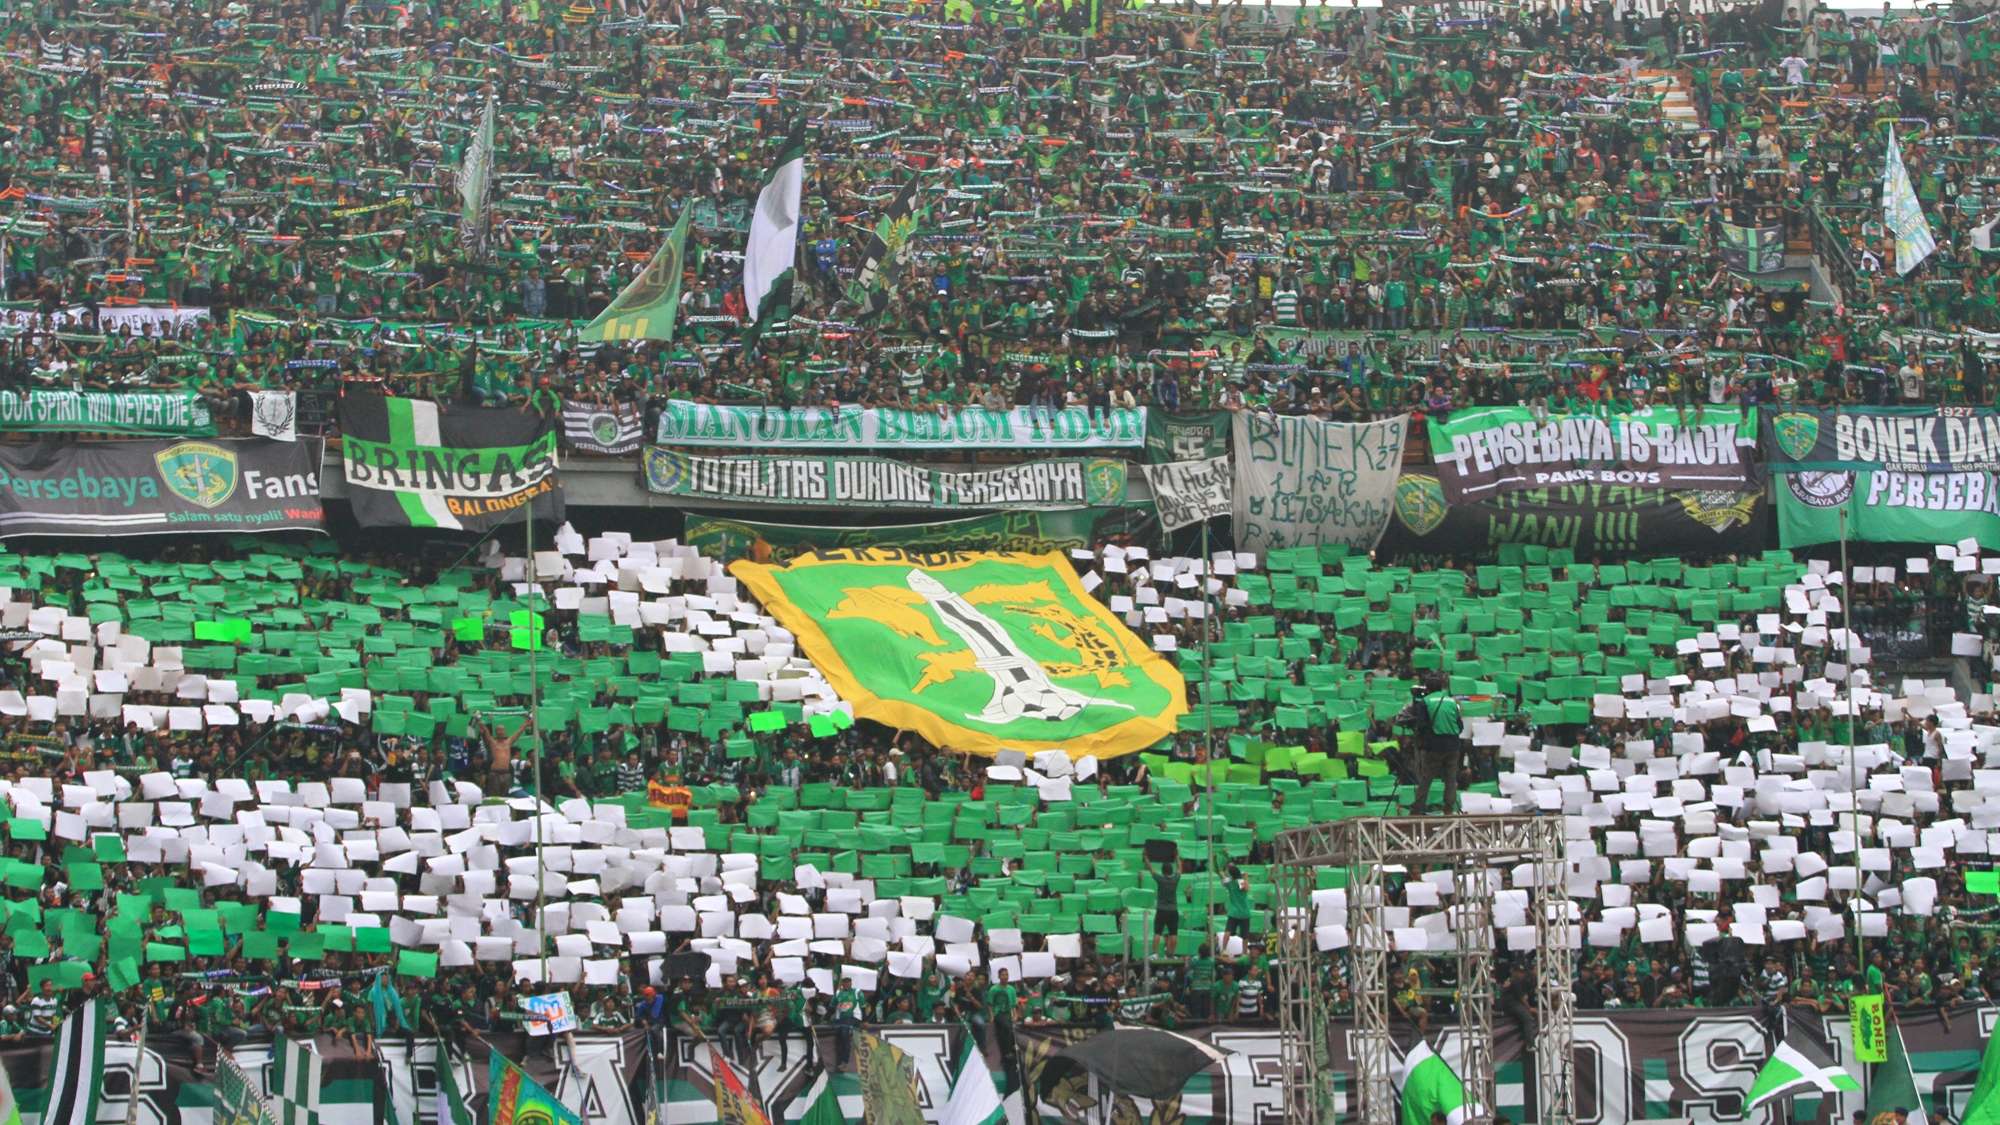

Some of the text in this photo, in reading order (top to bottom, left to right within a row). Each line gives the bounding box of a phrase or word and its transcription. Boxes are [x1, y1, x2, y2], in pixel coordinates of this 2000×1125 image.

[116, 394, 162, 425] NEVER
[166, 395, 189, 426] DIE
[663, 402, 864, 441] MANUKAN
[876, 407, 1015, 441] BELUM
[1935, 407, 1974, 417] 1927
[1453, 417, 1740, 476] PERSEBAYA IS BACK
[1836, 415, 1940, 463] BONEK
[350, 439, 553, 492] BRINGAS
[689, 457, 1083, 503] TOTALITAS DUKUNG PERSEBAYA
[1601, 470, 1660, 483] BOYS
[244, 471, 319, 499] Fans
[168, 511, 211, 523] Salam
[214, 512, 242, 522] satu
[245, 511, 283, 525] nyali!
[1488, 512, 1582, 549] WANI
